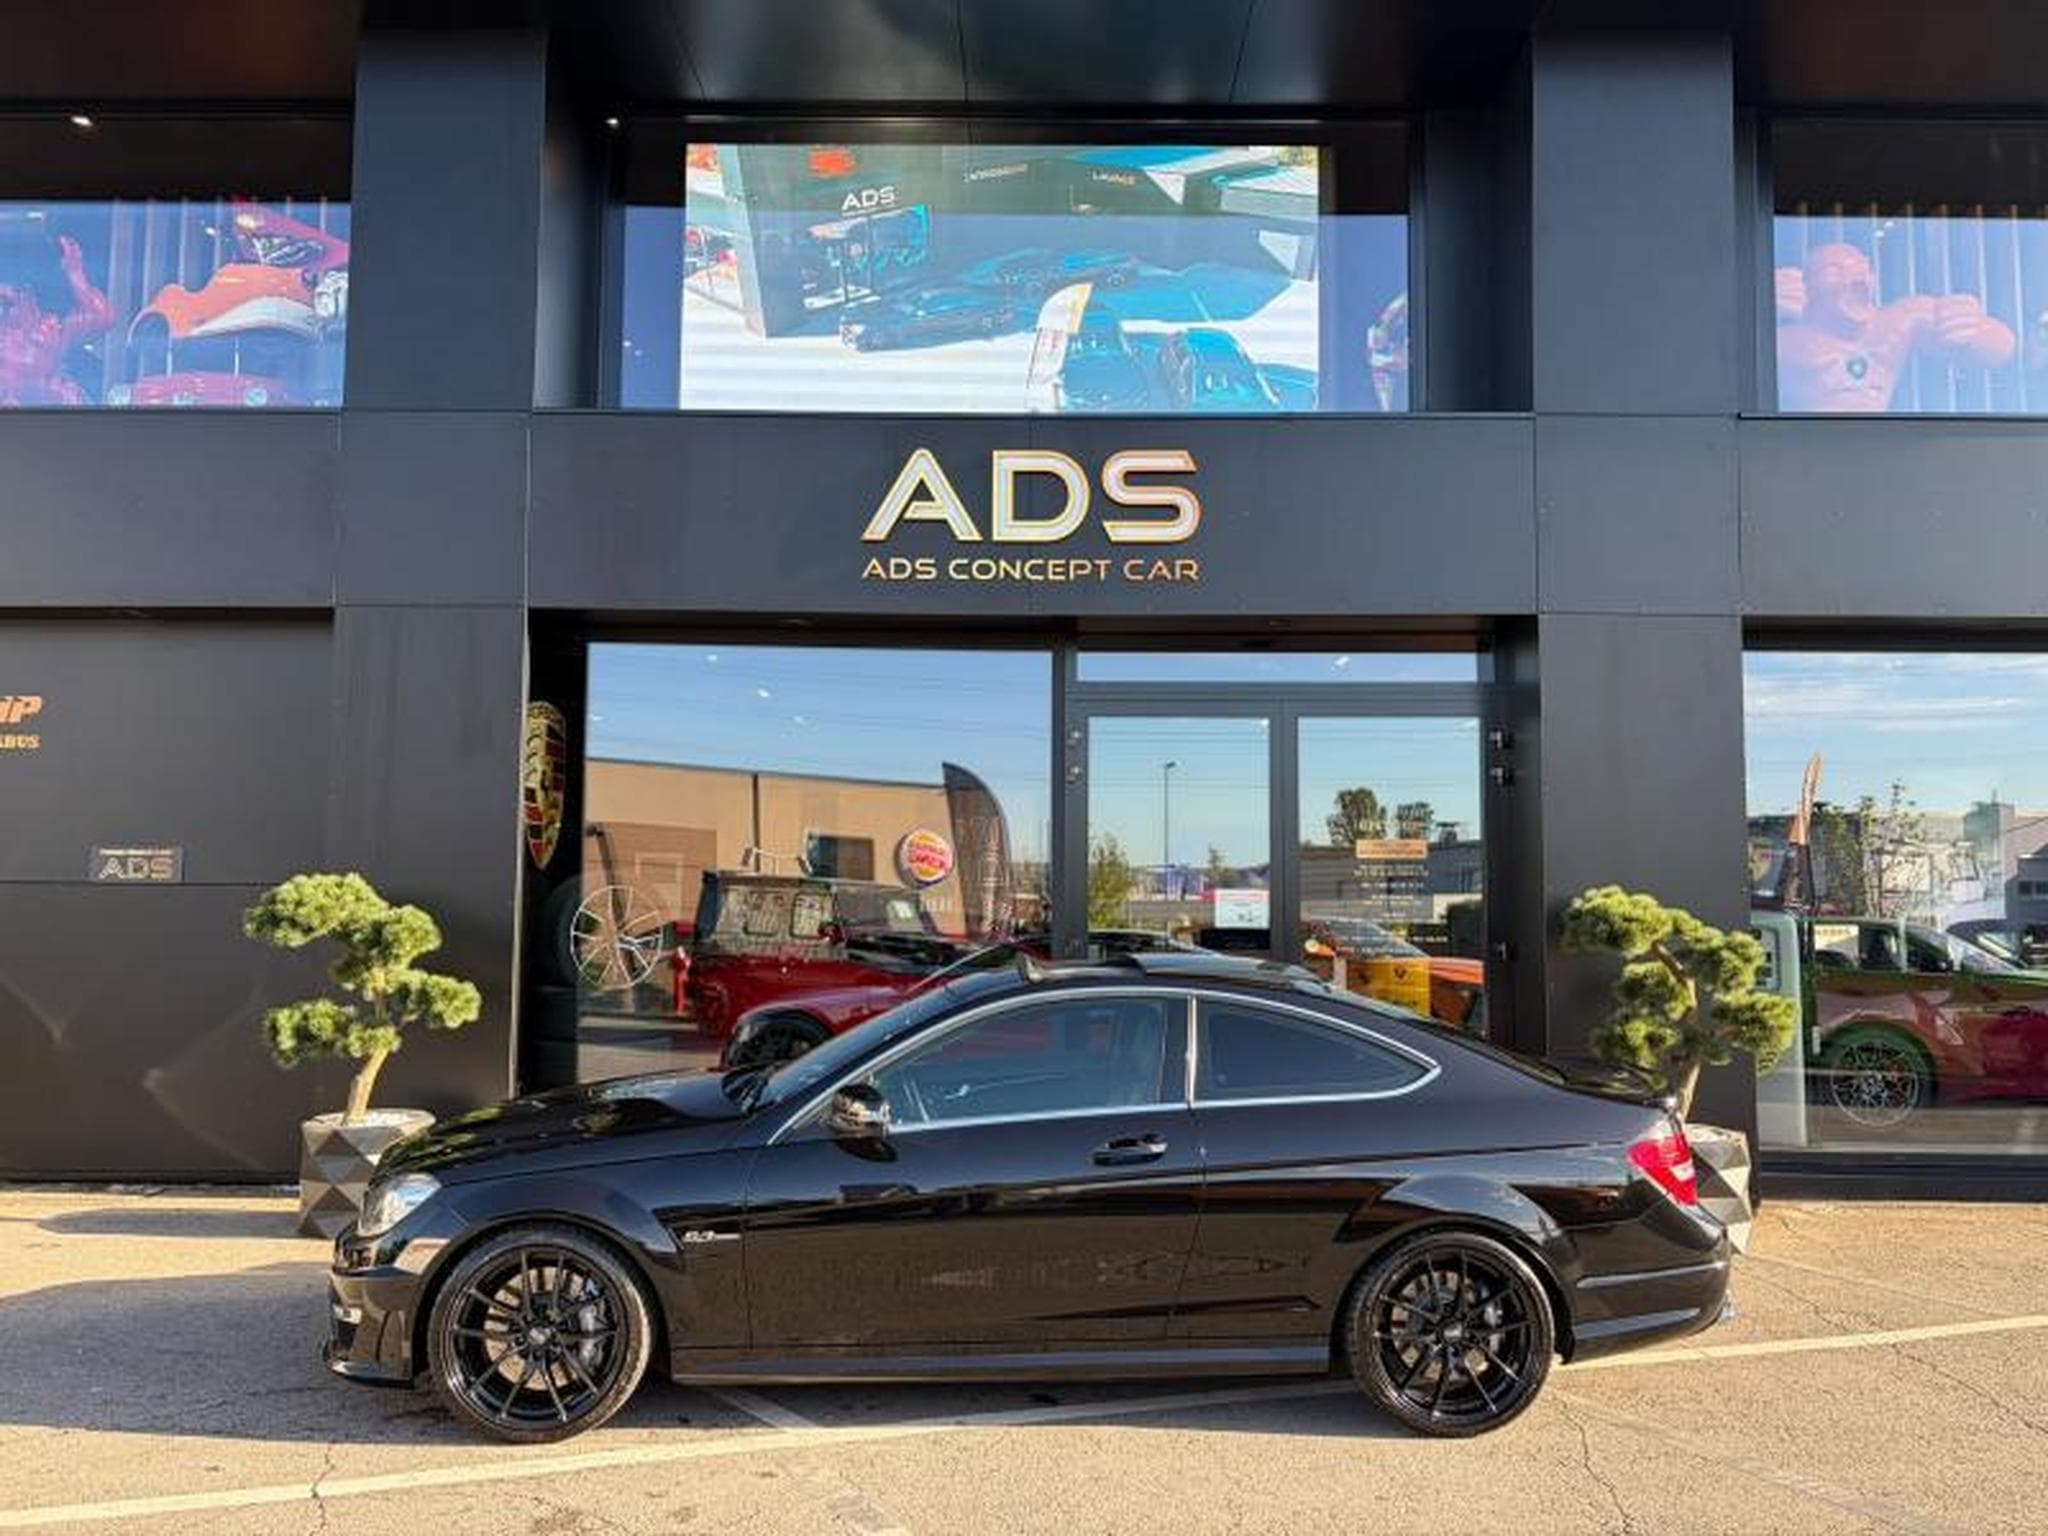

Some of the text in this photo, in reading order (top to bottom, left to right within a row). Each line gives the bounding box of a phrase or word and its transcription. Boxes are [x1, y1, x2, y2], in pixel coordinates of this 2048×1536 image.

[841, 186, 896, 211] ADS
[861, 448, 1202, 543] ADS
[861, 557, 1200, 581] ADS CONCEPT CAR
[98, 857, 173, 879] ADS
